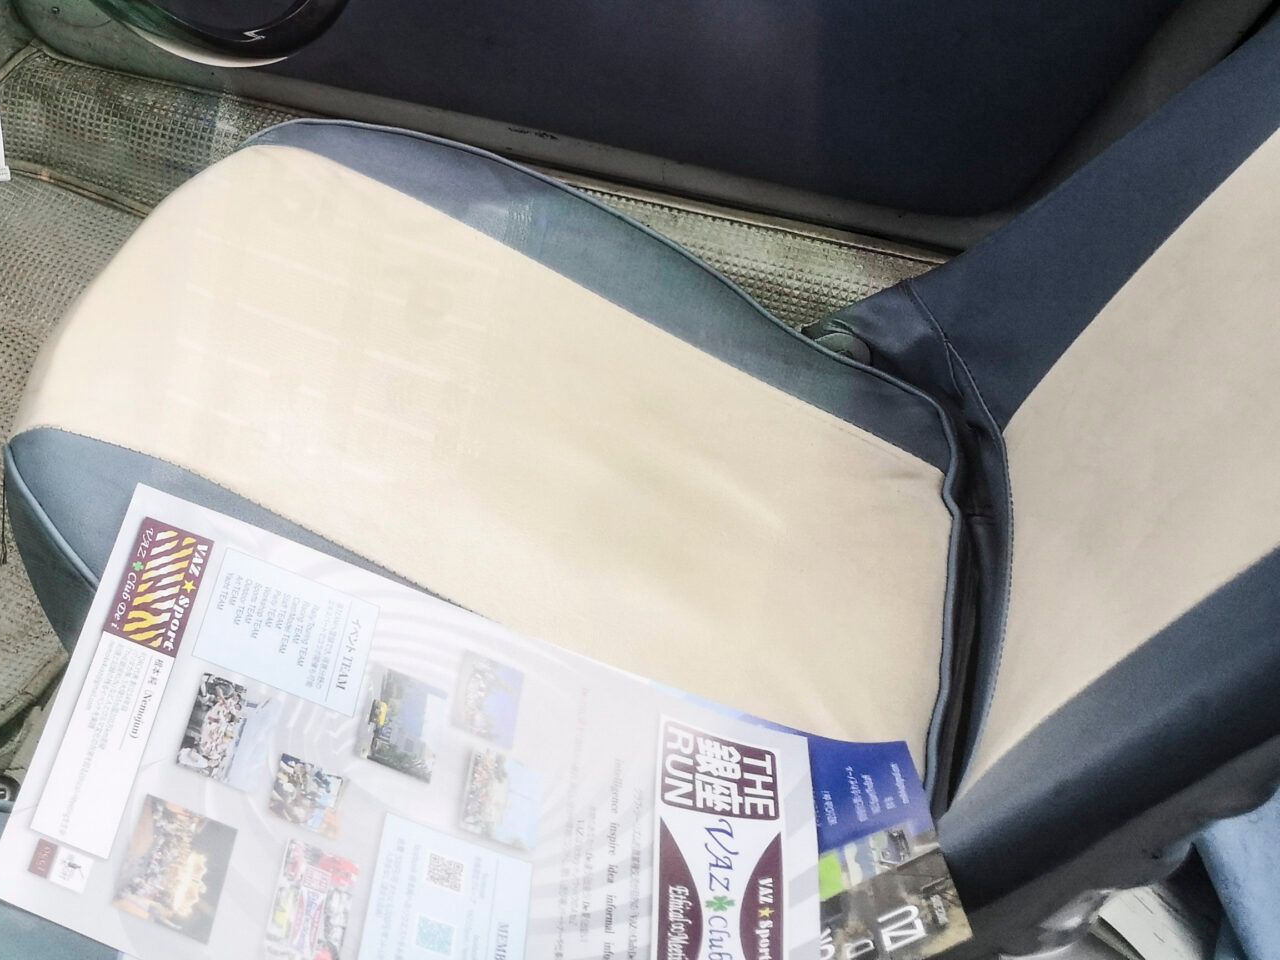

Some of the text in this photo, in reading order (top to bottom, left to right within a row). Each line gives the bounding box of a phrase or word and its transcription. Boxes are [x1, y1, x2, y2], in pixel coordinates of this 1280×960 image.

[135, 525, 155, 559] VAZ
[120, 571, 138, 601] Club
[160, 541, 208, 652] VAZ Sport
[215, 590, 228, 611] TEAM
[227, 585, 240, 606] TEAM
[232, 605, 245, 625] TEAM
[243, 603, 256, 624] TEAM
[249, 618, 262, 639] TEAM
[264, 607, 276, 628] TEAM
[274, 609, 286, 630] TEAM
[277, 633, 290, 654] TEAM
[291, 624, 303, 644] TEAM
[296, 646, 308, 667] TEAM
[333, 655, 354, 691] TEAM
[664, 726, 693, 805] RUN
[694, 737, 742, 815] 銀座
[608, 758, 625, 814] intelligence
[742, 754, 774, 815] THE
[605, 821, 620, 856] inspire
[703, 818, 738, 891] VAZ
[606, 863, 617, 884] idea
[602, 893, 617, 933] informal
[754, 877, 773, 960] VAZ Sport
